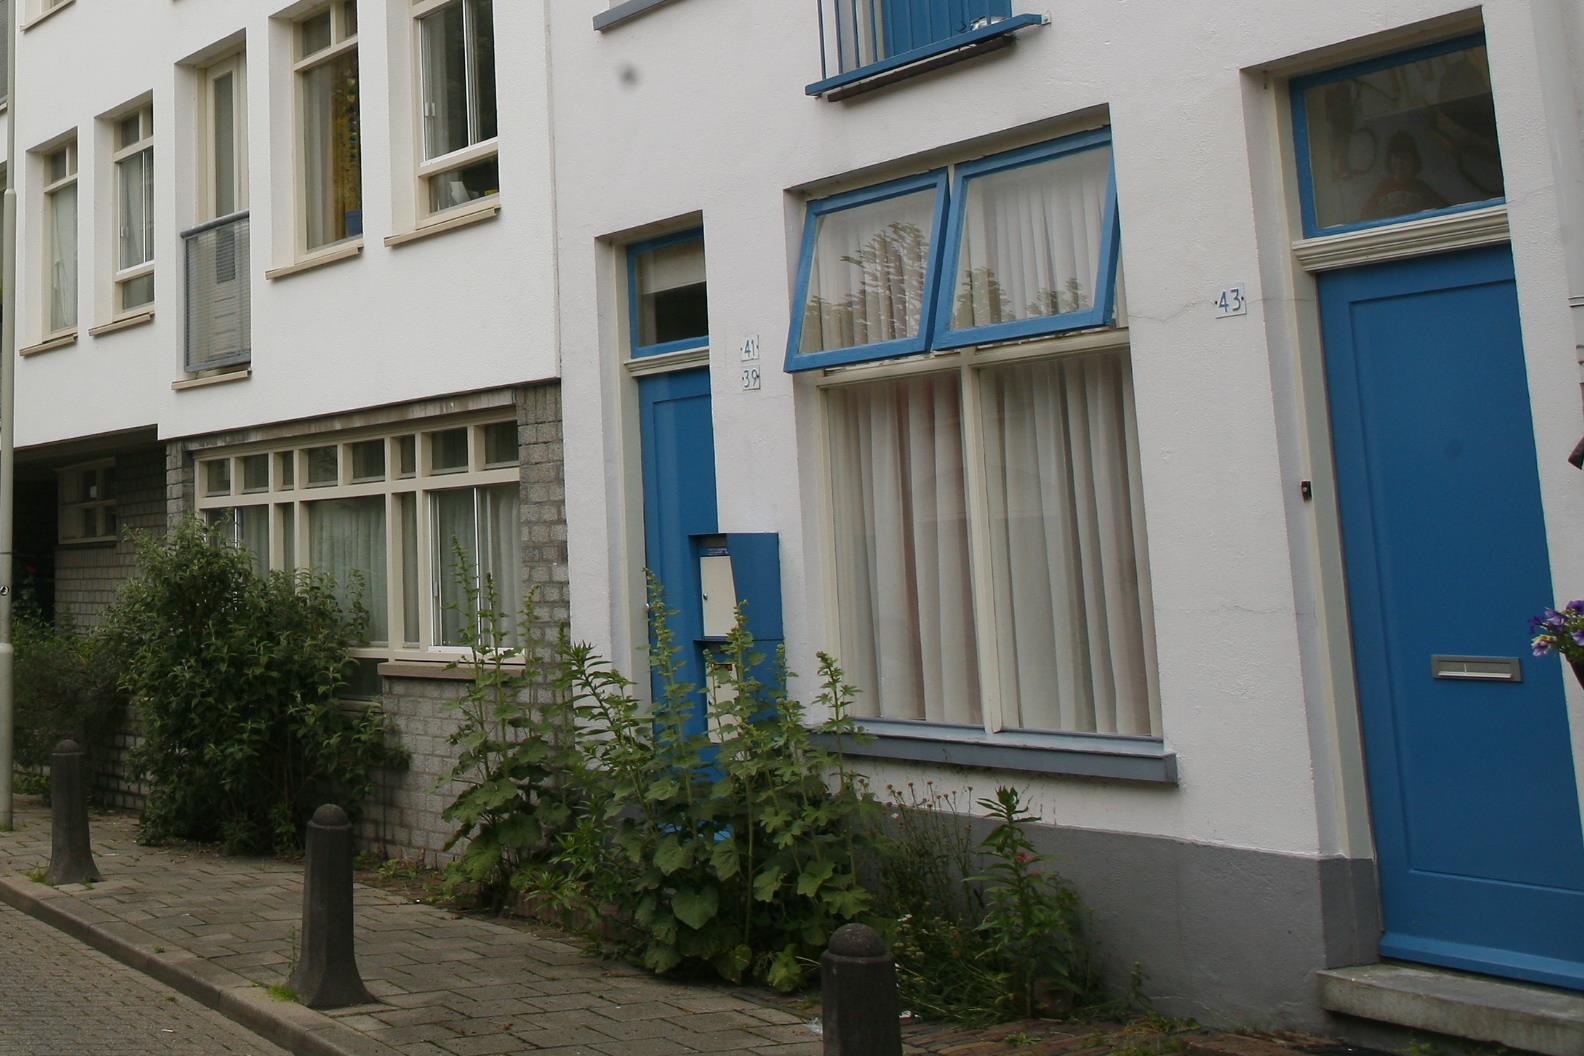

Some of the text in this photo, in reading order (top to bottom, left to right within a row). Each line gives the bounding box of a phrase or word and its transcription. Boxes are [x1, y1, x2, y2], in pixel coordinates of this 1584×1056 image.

[1219, 289, 1241, 313] 43
[744, 339, 755, 358] 41
[744, 369, 758, 388] 39
